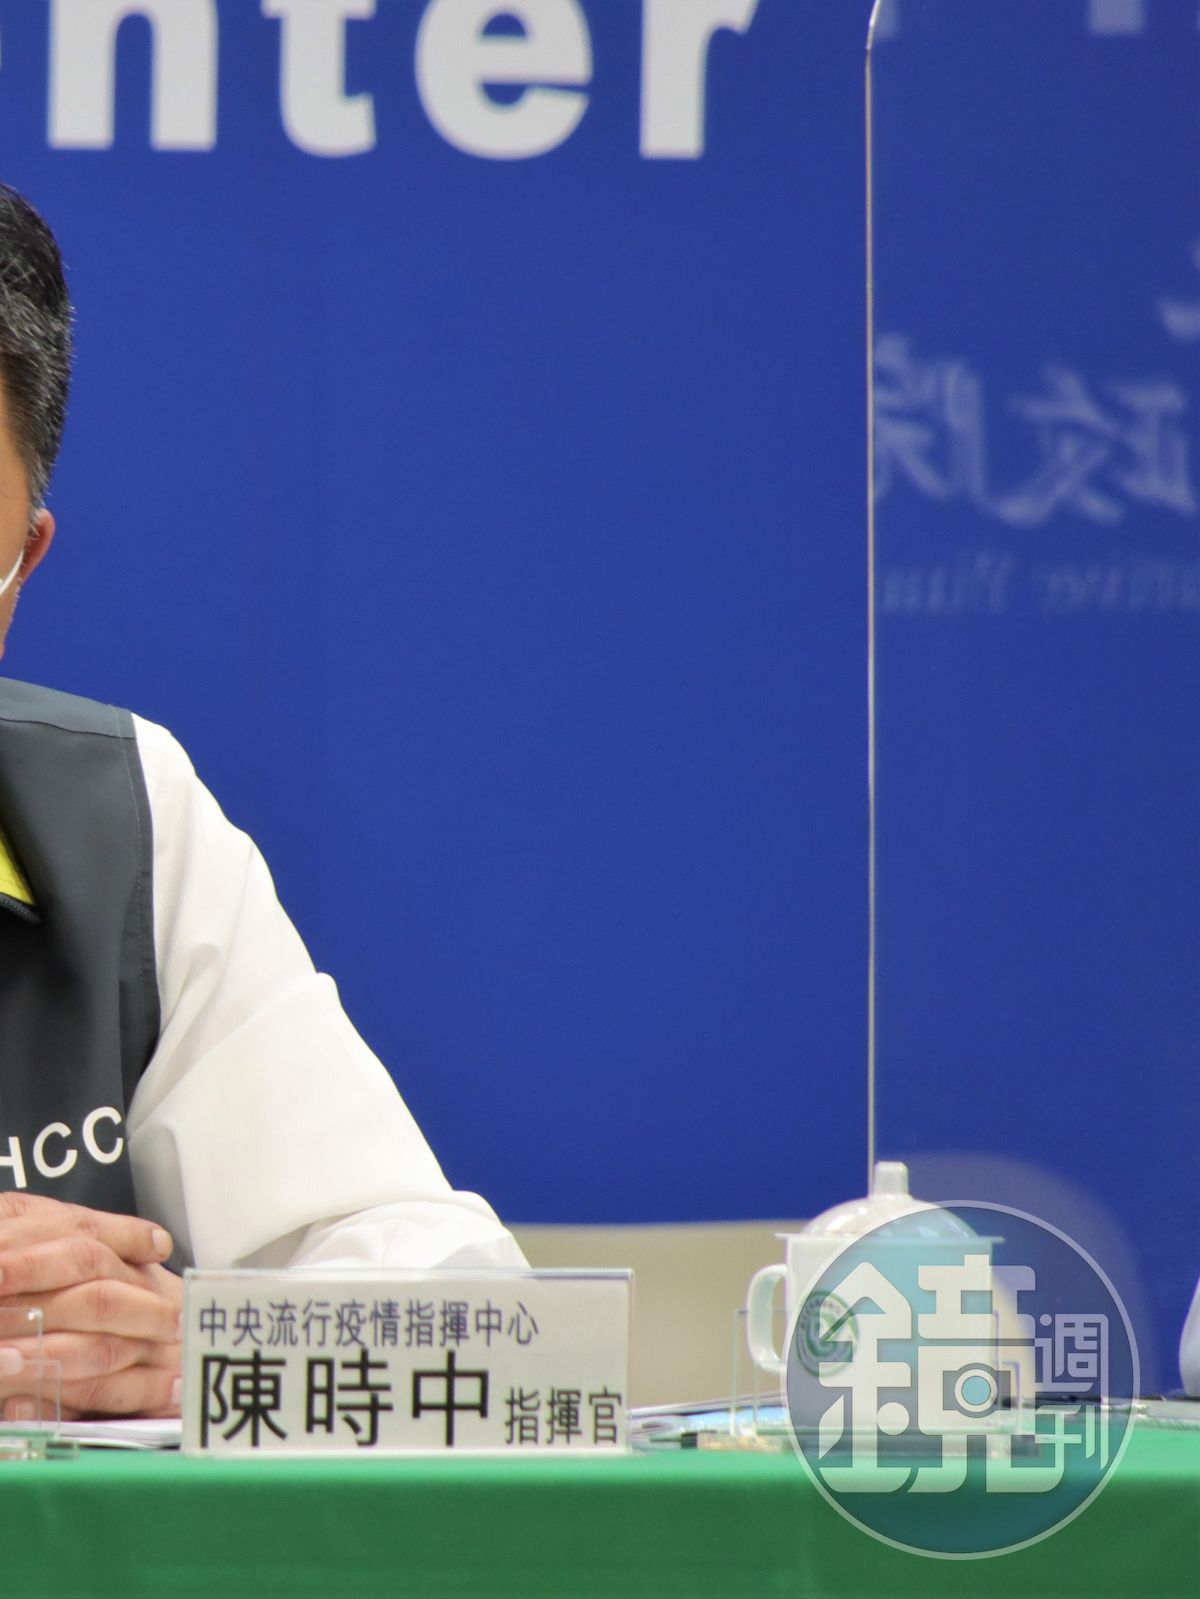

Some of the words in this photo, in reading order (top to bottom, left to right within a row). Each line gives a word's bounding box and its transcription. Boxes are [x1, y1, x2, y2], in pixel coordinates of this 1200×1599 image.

[201, 1299, 538, 1347] 中央流行疫情指揮中心
[201, 1349, 489, 1448] 陳時中
[504, 1386, 622, 1445] 指揮官
